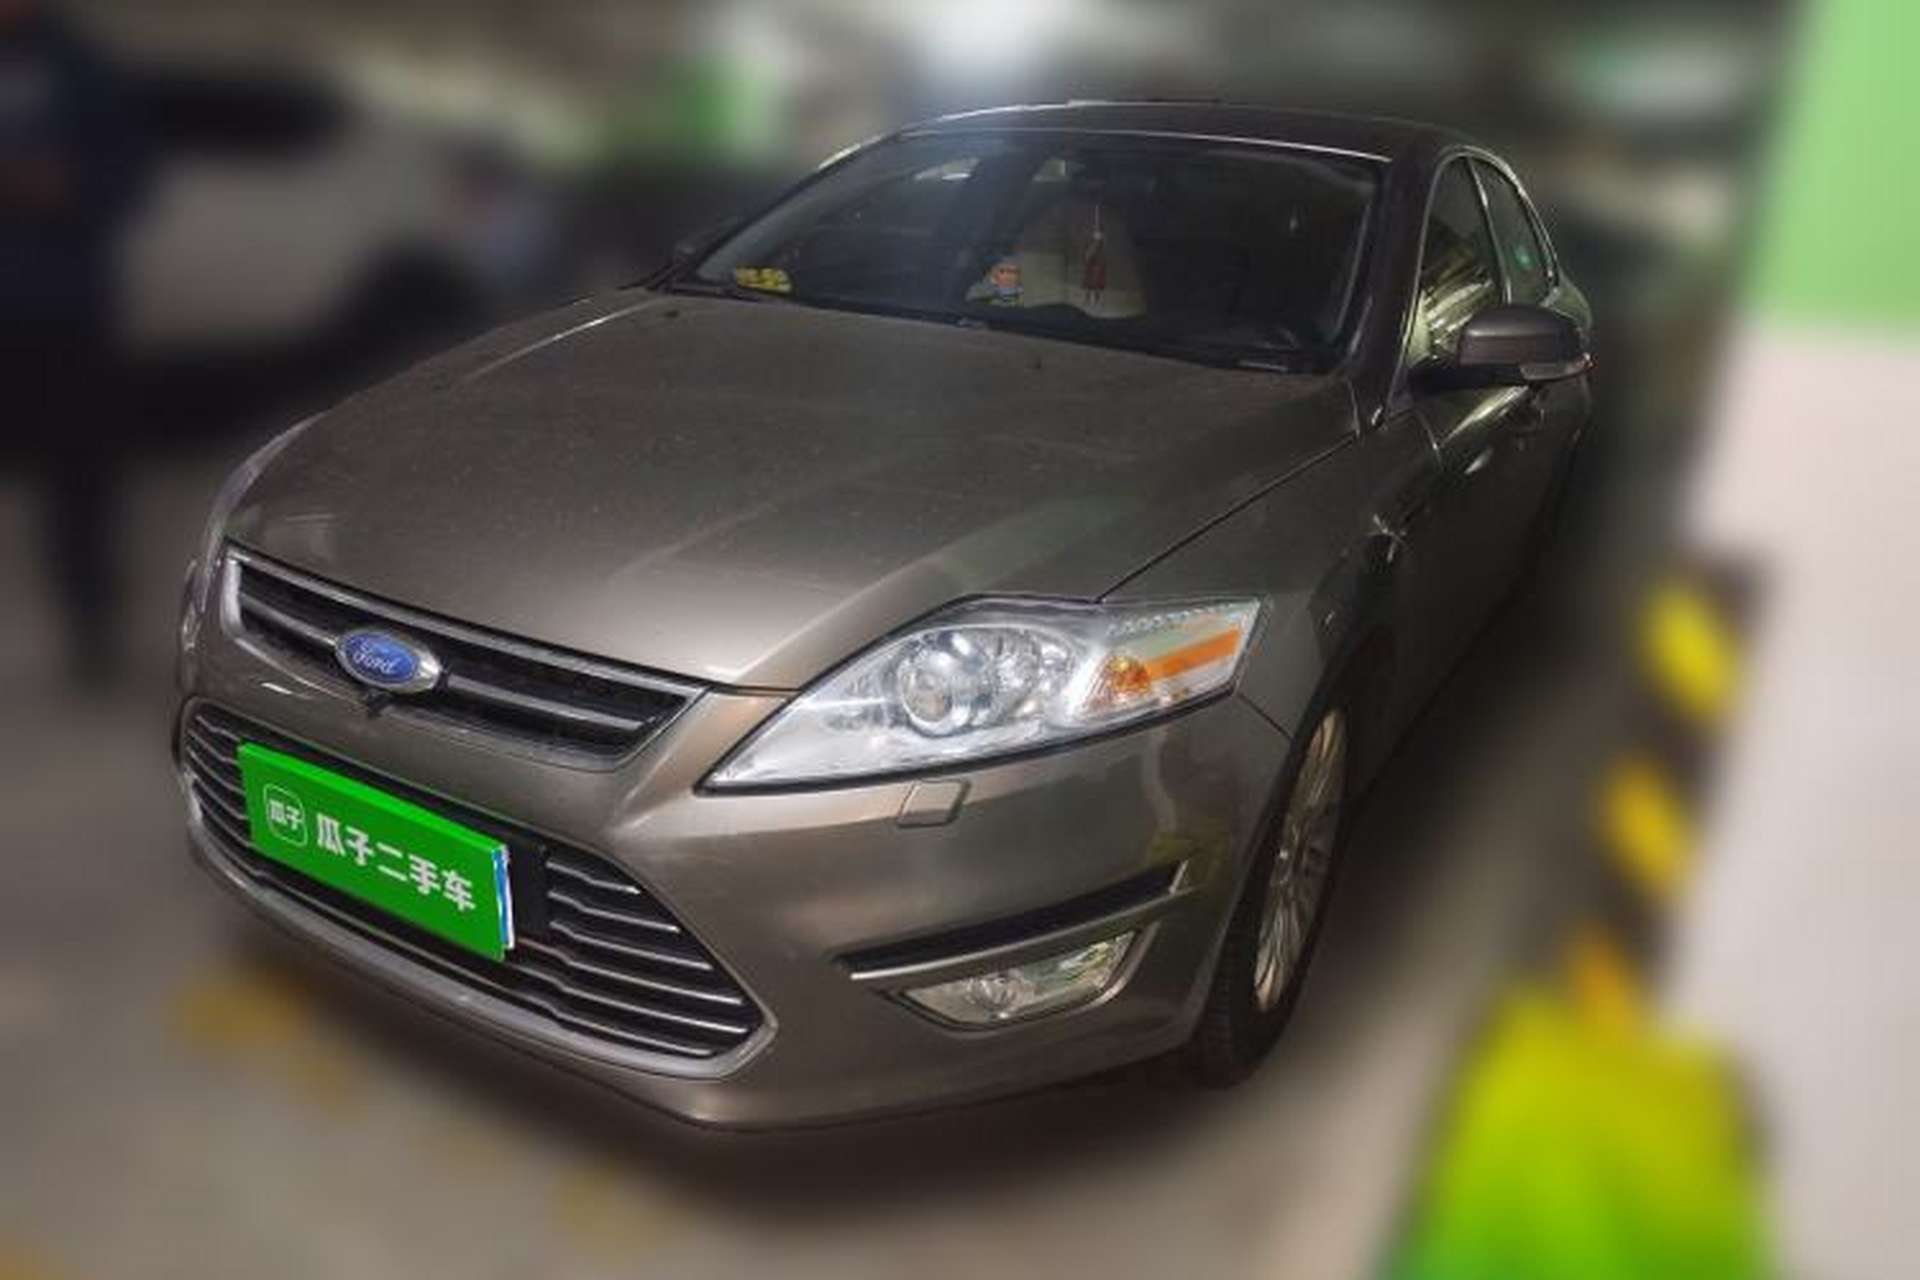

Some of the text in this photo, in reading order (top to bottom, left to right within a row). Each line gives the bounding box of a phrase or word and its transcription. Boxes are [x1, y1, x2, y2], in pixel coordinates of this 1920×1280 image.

[352, 639, 401, 675] Ford
[269, 799, 302, 831] 瓜子
[316, 813, 476, 912] 瓜子二手车
